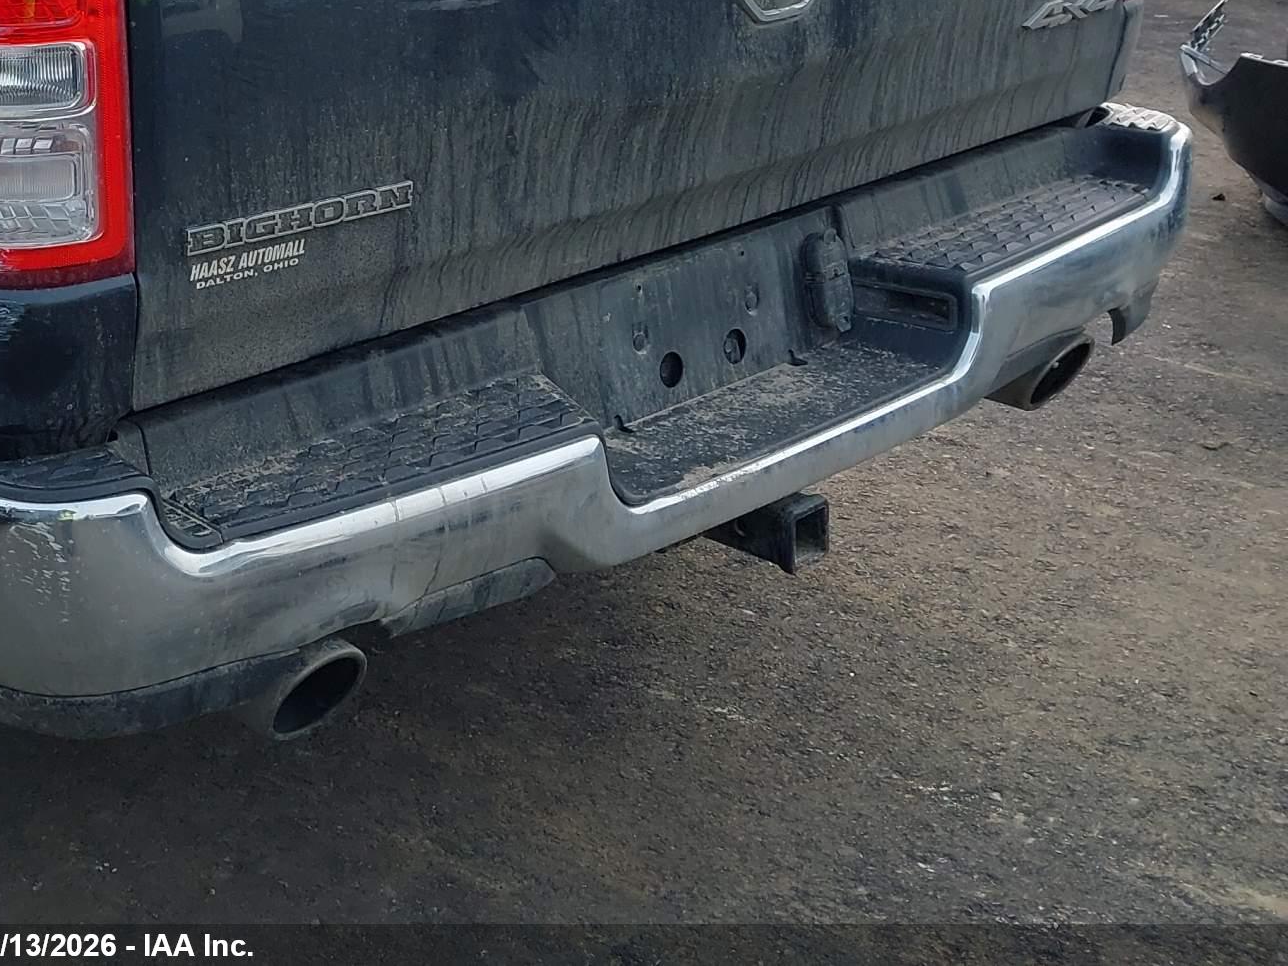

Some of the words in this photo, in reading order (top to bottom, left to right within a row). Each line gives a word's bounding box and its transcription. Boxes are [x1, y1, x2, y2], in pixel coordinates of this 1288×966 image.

[186, 180, 414, 257] BIGHORN
[190, 255, 235, 282] HAASZ
[238, 239, 306, 271] AUTOMALL
[196, 269, 259, 290] DALTON,
[263, 258, 299, 274] OHIO
